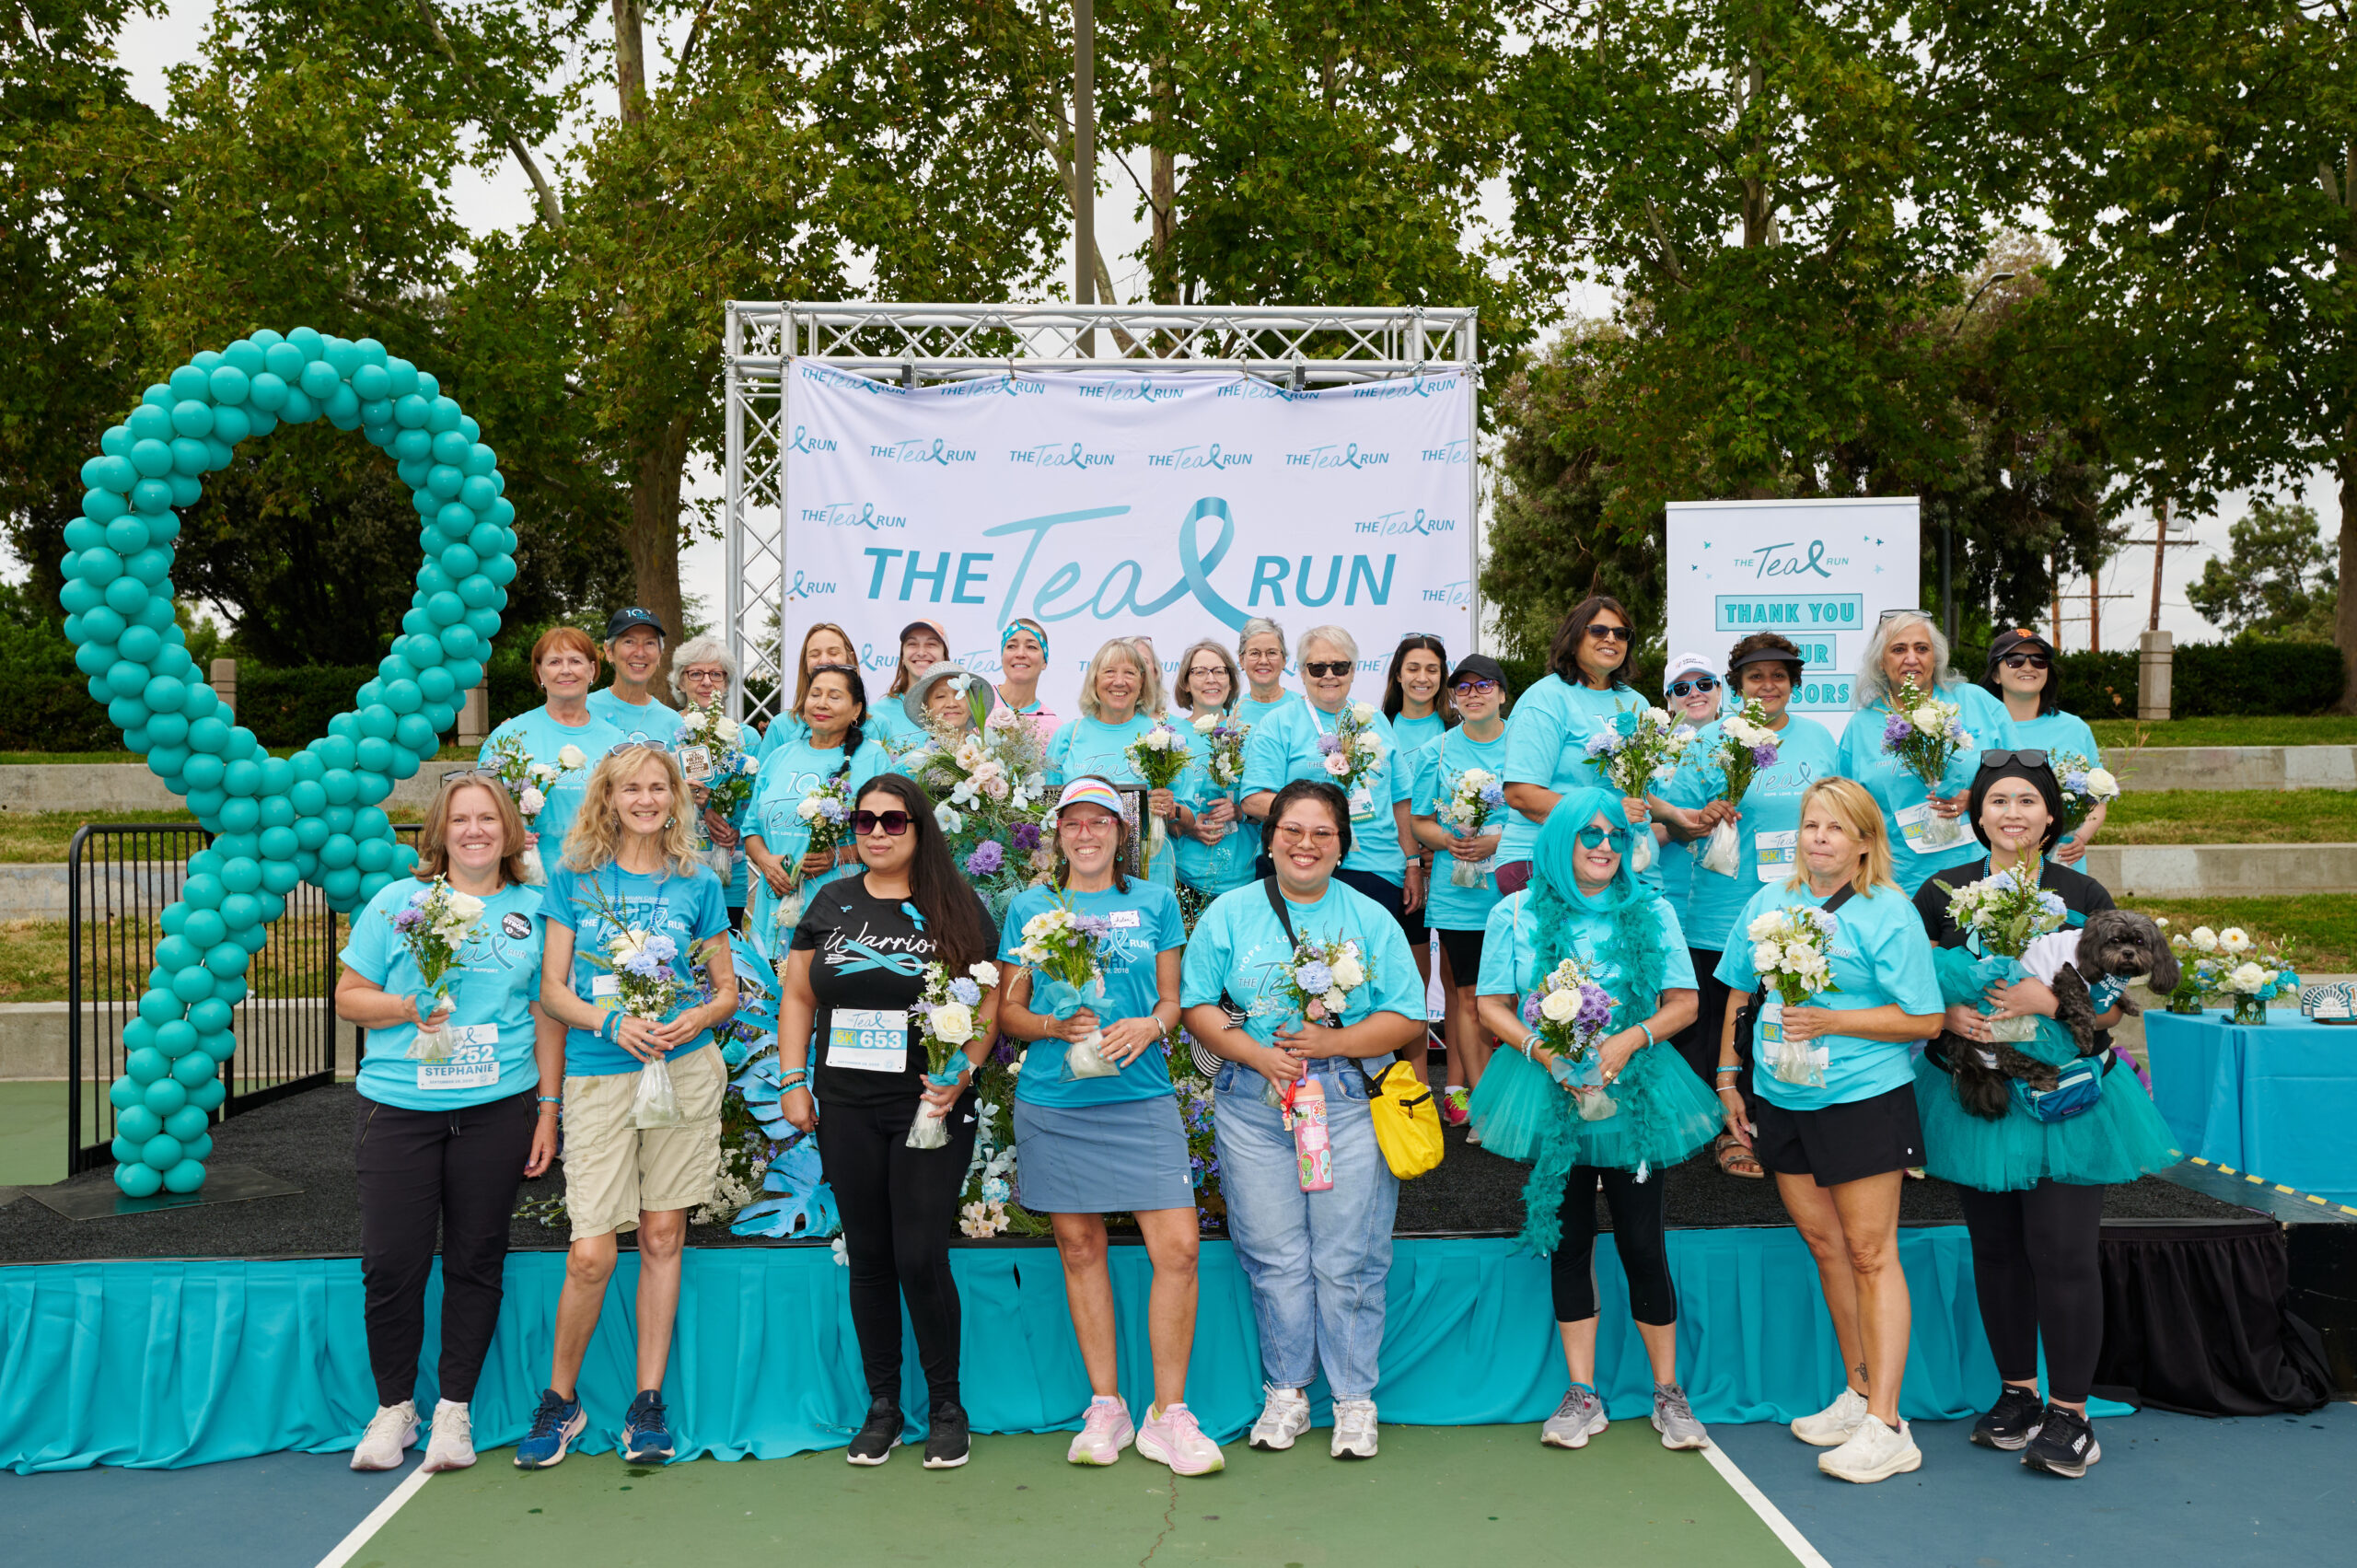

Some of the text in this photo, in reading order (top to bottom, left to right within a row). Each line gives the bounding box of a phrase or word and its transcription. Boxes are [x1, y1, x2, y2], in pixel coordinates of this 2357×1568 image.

[801, 366, 826, 383] THE
[941, 386, 965, 396] THE
[1015, 380, 1045, 395] RUN
[1078, 377, 1184, 403] THE Teal RUN
[1217, 385, 1241, 398] THE
[1353, 388, 1378, 399] THE
[1427, 378, 1457, 394] RUN
[807, 436, 838, 452] RUN
[869, 438, 976, 466] THE Teal RUN
[1009, 442, 1116, 470] THE Teal RUN
[1147, 444, 1252, 470] THE Teal RUN
[1285, 443, 1389, 470] THE Teal RUN
[1422, 449, 1446, 461] THE
[801, 503, 907, 530] THE Teal RUN
[1354, 508, 1456, 537] THE Teal RUN
[864, 547, 994, 605] THE
[981, 496, 1254, 633] Teal
[1247, 553, 1397, 608] RUN
[1734, 540, 1849, 579] THE Teal RUN
[807, 582, 836, 595] RUN
[1422, 589, 1446, 601] THE
[1724, 602, 1854, 623] THANK YOU
[963, 649, 1002, 674] Tea
[1796, 645, 1829, 663] UR
[1357, 660, 1381, 672] THE
[764, 797, 808, 830] Tea
[1906, 825, 1923, 837] 5K
[1762, 851, 1777, 862] 5K
[582, 918, 598, 928] THE
[668, 920, 686, 932] RUN
[1130, 939, 1150, 950] RUN
[1239, 944, 1262, 972] HOPE
[1238, 978, 1258, 987] THE
[598, 998, 616, 1009] 5K
[853, 1011, 886, 1029] Teal
[836, 1031, 902, 1048] 5K 653
[1764, 1024, 1775, 1039] 5K
[425, 1064, 493, 1076] STEPHANIE
